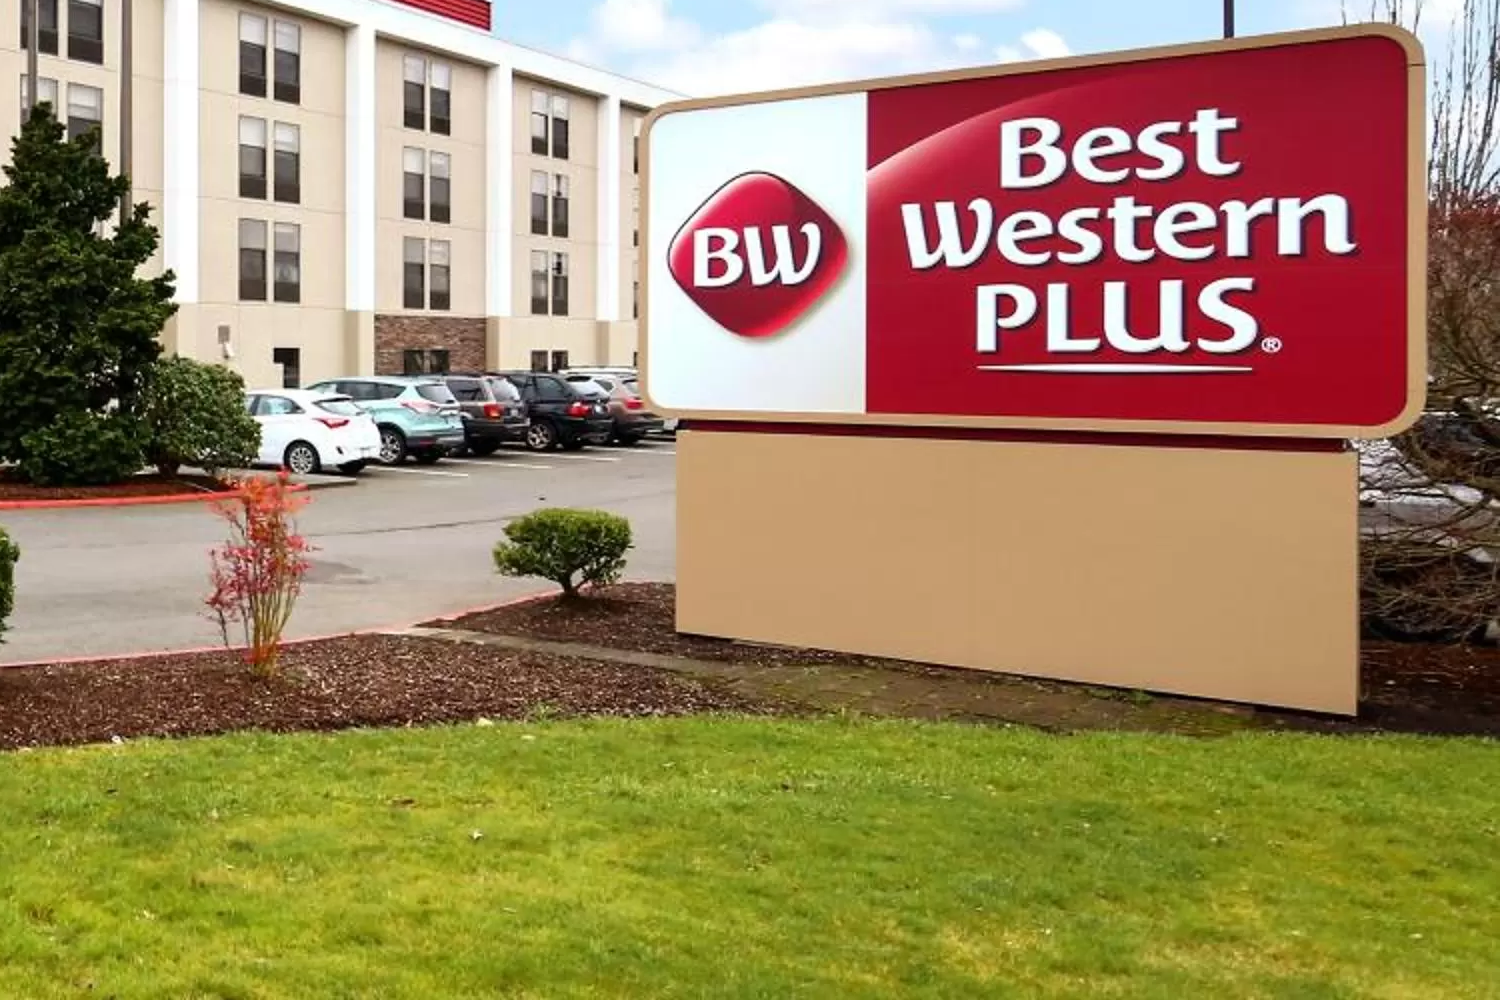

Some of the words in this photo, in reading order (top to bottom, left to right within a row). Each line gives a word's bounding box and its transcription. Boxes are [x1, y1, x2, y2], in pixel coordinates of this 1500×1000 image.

[1000, 108, 1241, 188] Best
[693, 221, 822, 287] BW
[901, 194, 1357, 269] Western
[977, 277, 1257, 353] PLUS
